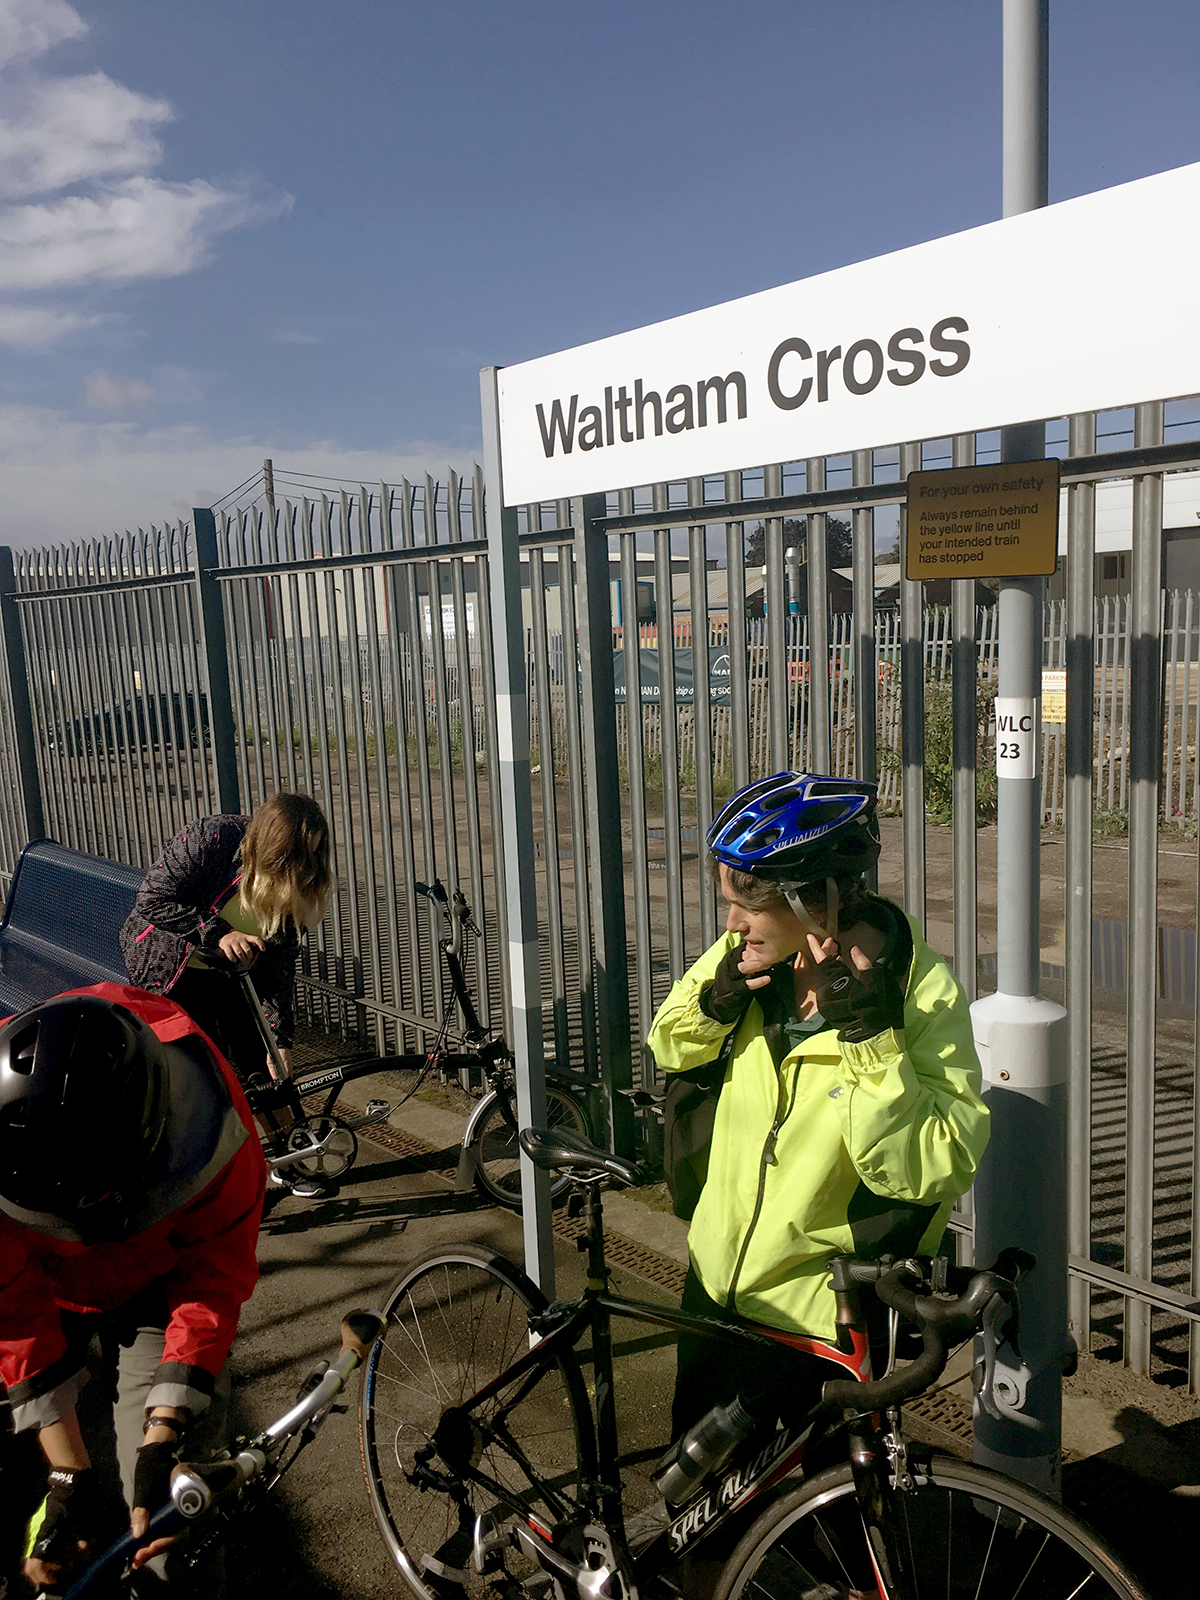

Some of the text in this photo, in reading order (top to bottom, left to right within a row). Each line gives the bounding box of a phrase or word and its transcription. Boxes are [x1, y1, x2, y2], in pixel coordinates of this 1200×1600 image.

[536, 316, 971, 458] Waltham Cross
[920, 476, 1044, 498] For your own safety
[920, 503, 1038, 522] Always remain behind
[920, 519, 1021, 536] the yellow line until
[919, 534, 1020, 552] your intended train
[919, 551, 984, 564] has stopped
[1000, 742, 1021, 759] 23
[772, 824, 829, 852] SPECIALIZED
[300, 1071, 340, 1091] BROMPTON
